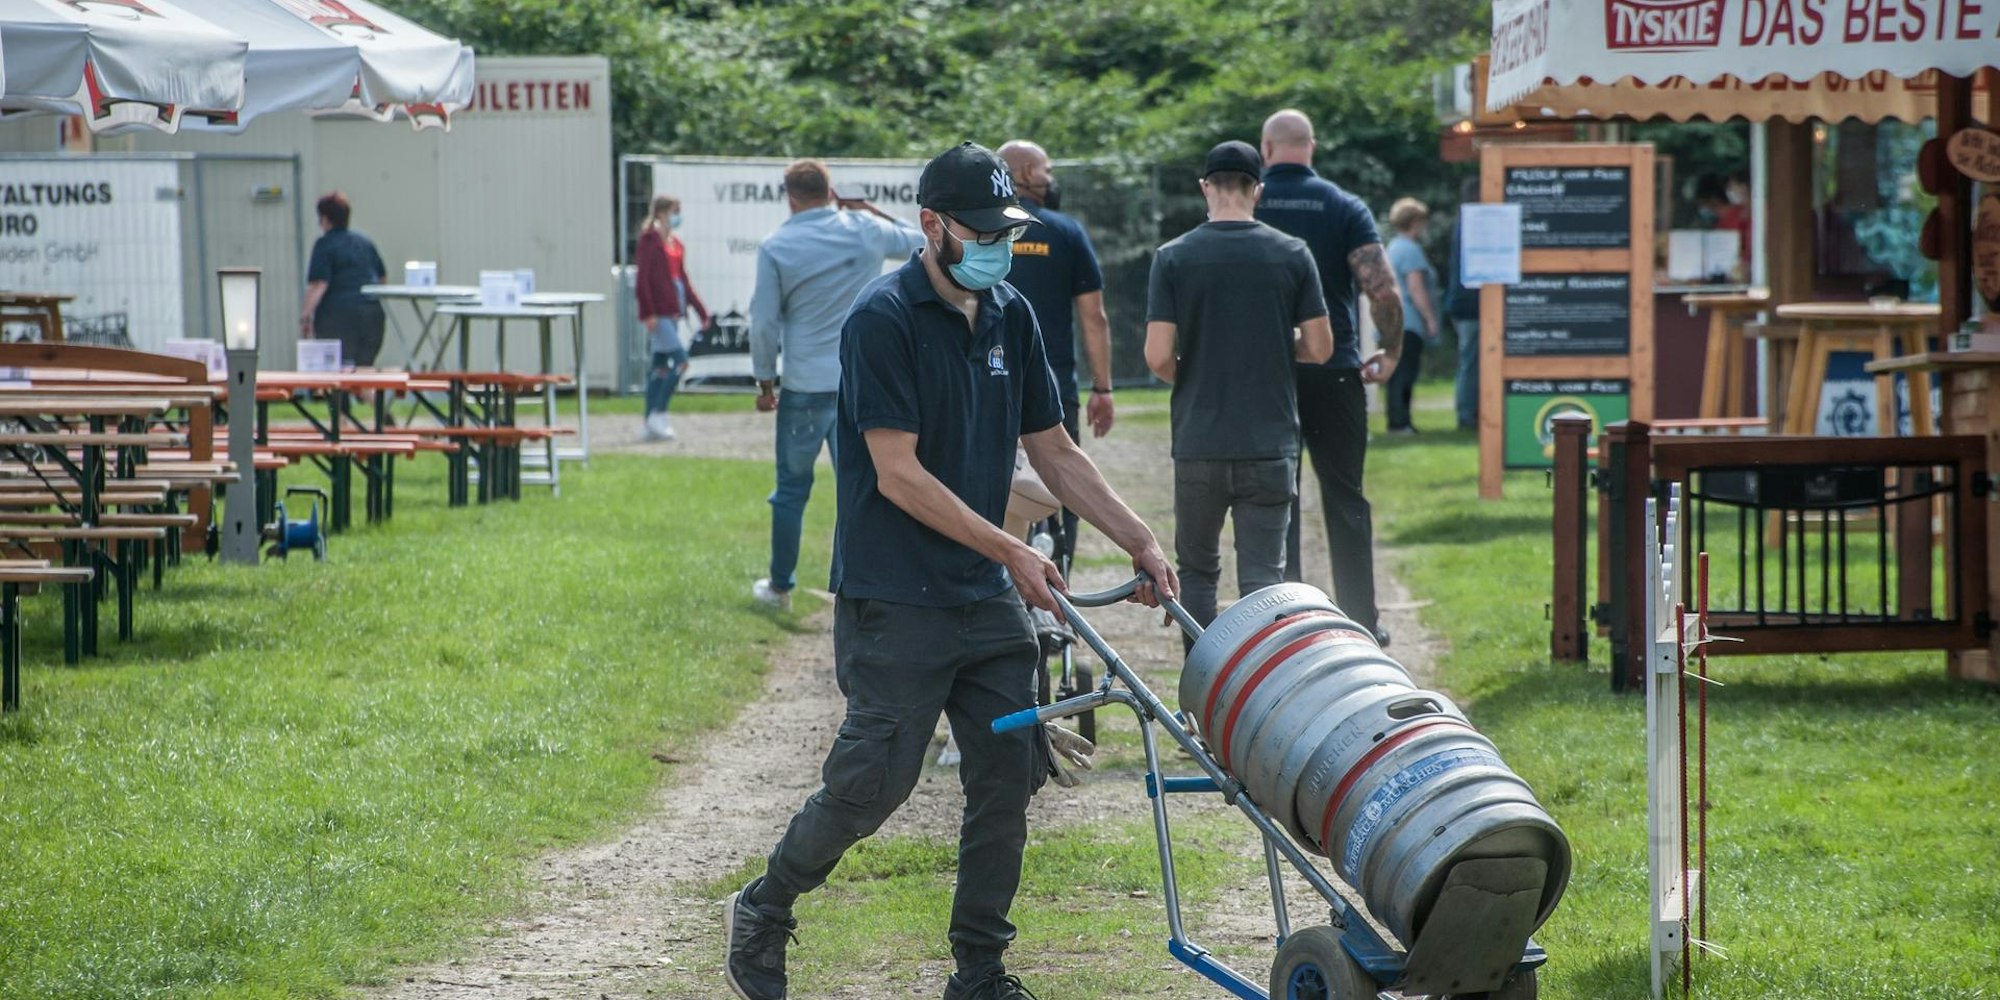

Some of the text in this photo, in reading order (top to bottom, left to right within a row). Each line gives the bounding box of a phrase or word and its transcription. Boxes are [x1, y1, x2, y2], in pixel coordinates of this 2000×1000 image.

[1610, 3, 1718, 44] TYSKIE
[1739, 0, 1824, 46] DAS
[1842, 0, 1982, 43] BESTE
